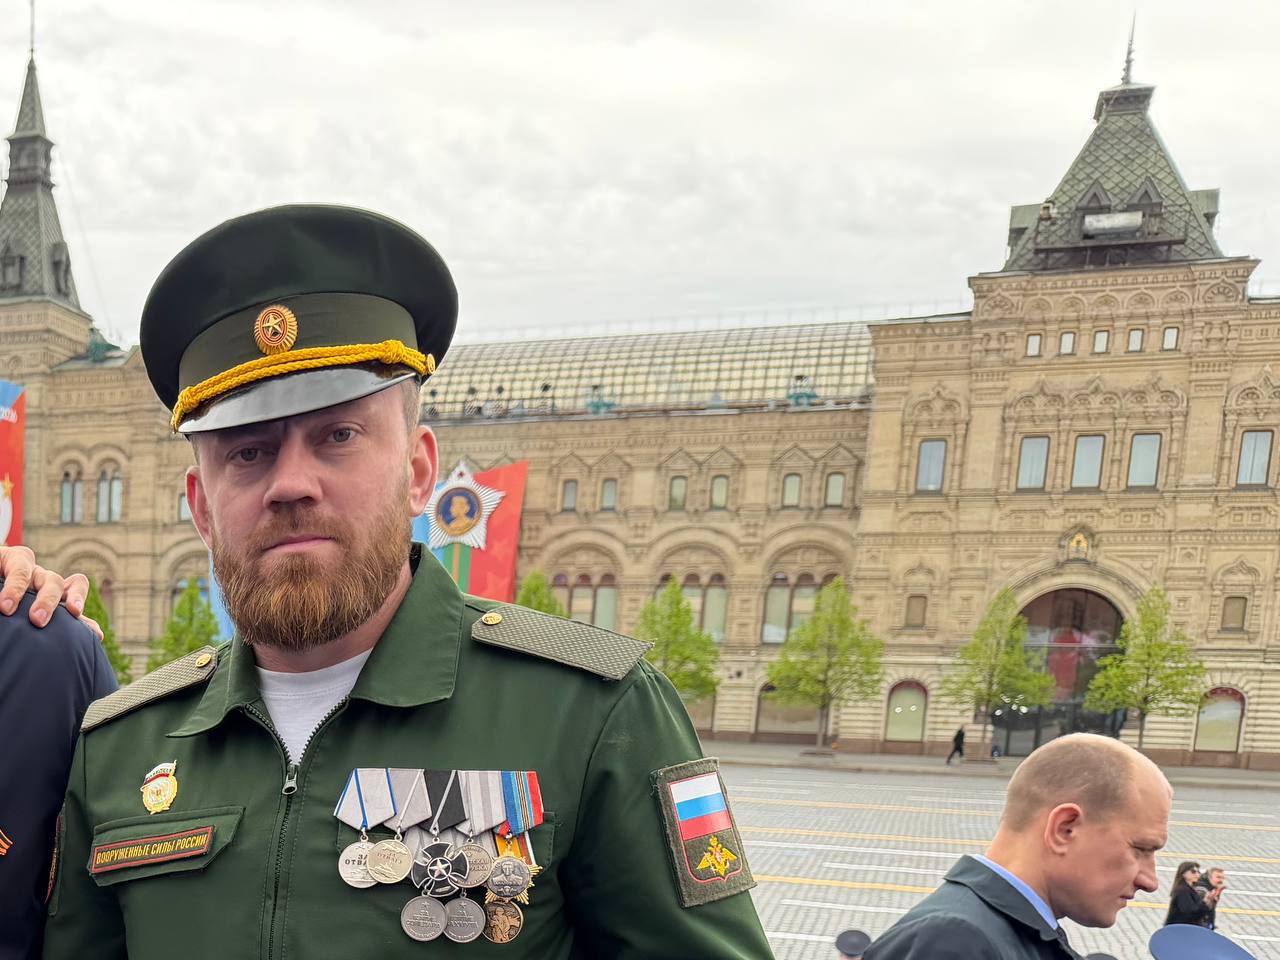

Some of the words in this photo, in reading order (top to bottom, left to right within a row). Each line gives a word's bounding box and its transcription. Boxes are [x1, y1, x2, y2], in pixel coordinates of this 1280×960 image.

[96, 844, 151, 864] ВООРУЖЕННЫЕ
[151, 840, 176, 855] СИЛЫ
[176, 834, 207, 850] РОССИИ
